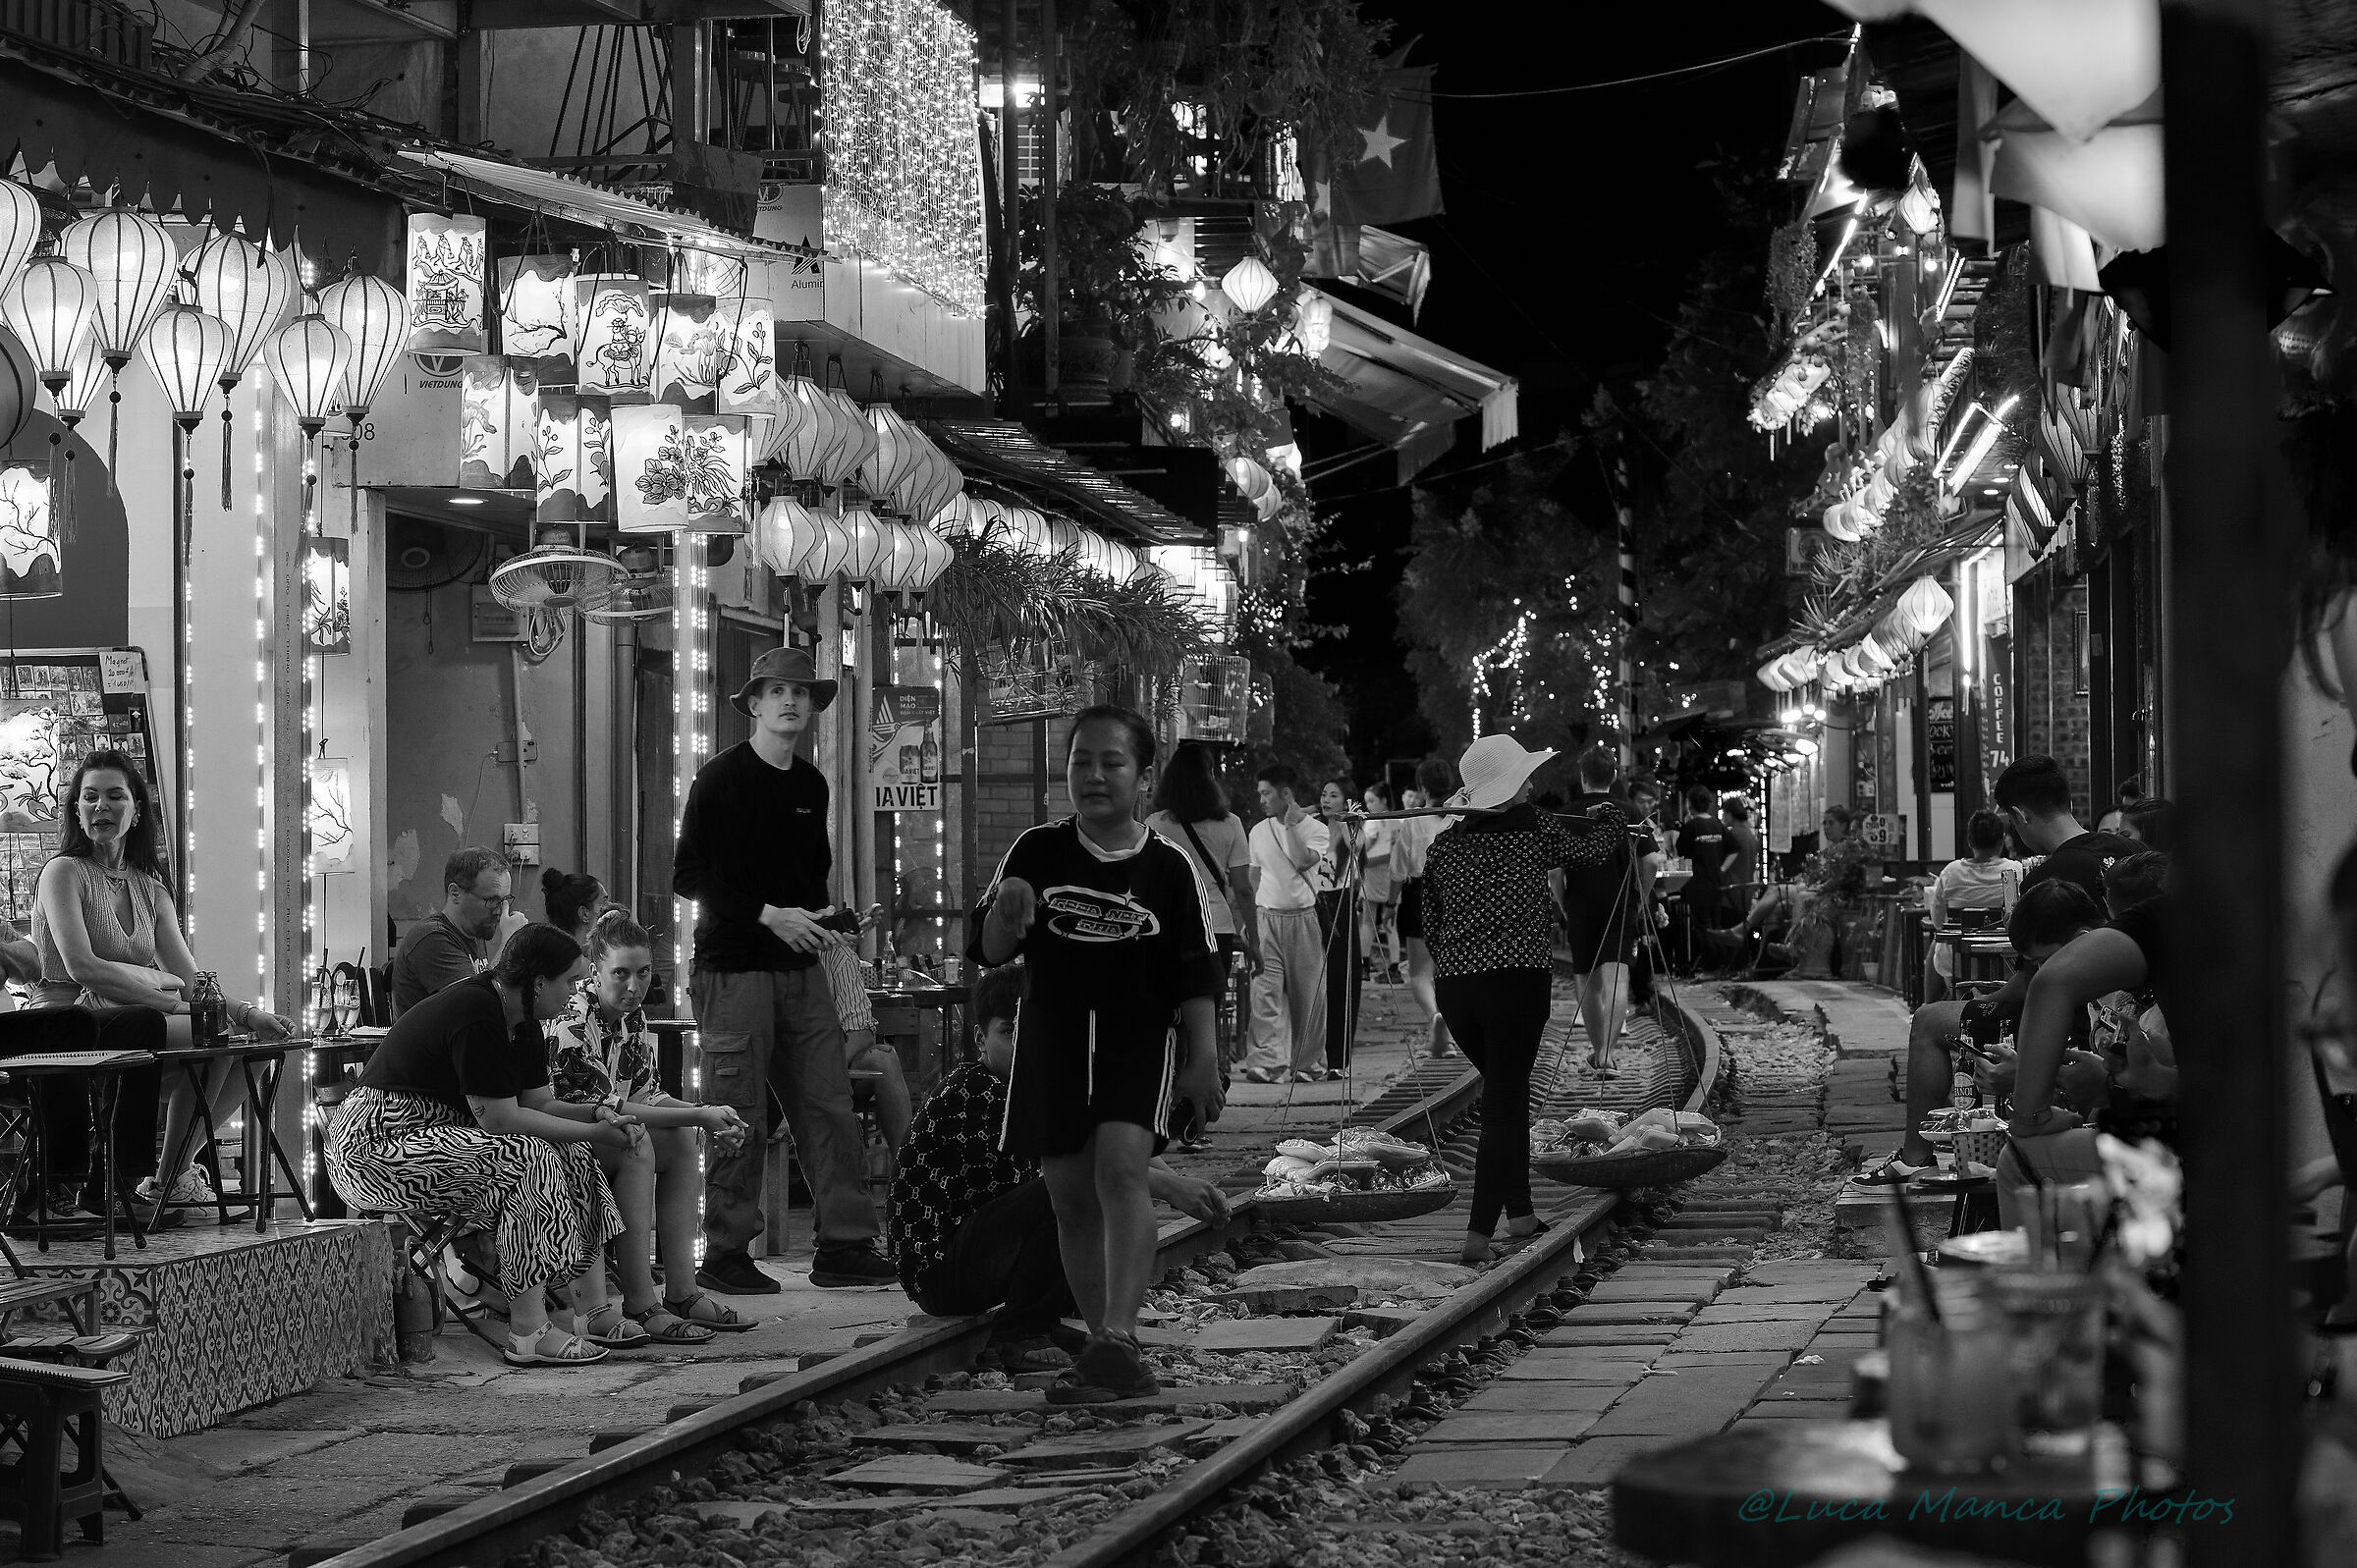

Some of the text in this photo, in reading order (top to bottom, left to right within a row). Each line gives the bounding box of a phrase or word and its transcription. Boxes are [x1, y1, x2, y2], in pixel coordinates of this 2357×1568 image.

[419, 380, 463, 389] VIETDUNG
[1993, 673, 2004, 744] COFFEE
[1990, 750, 2010, 769] 74
